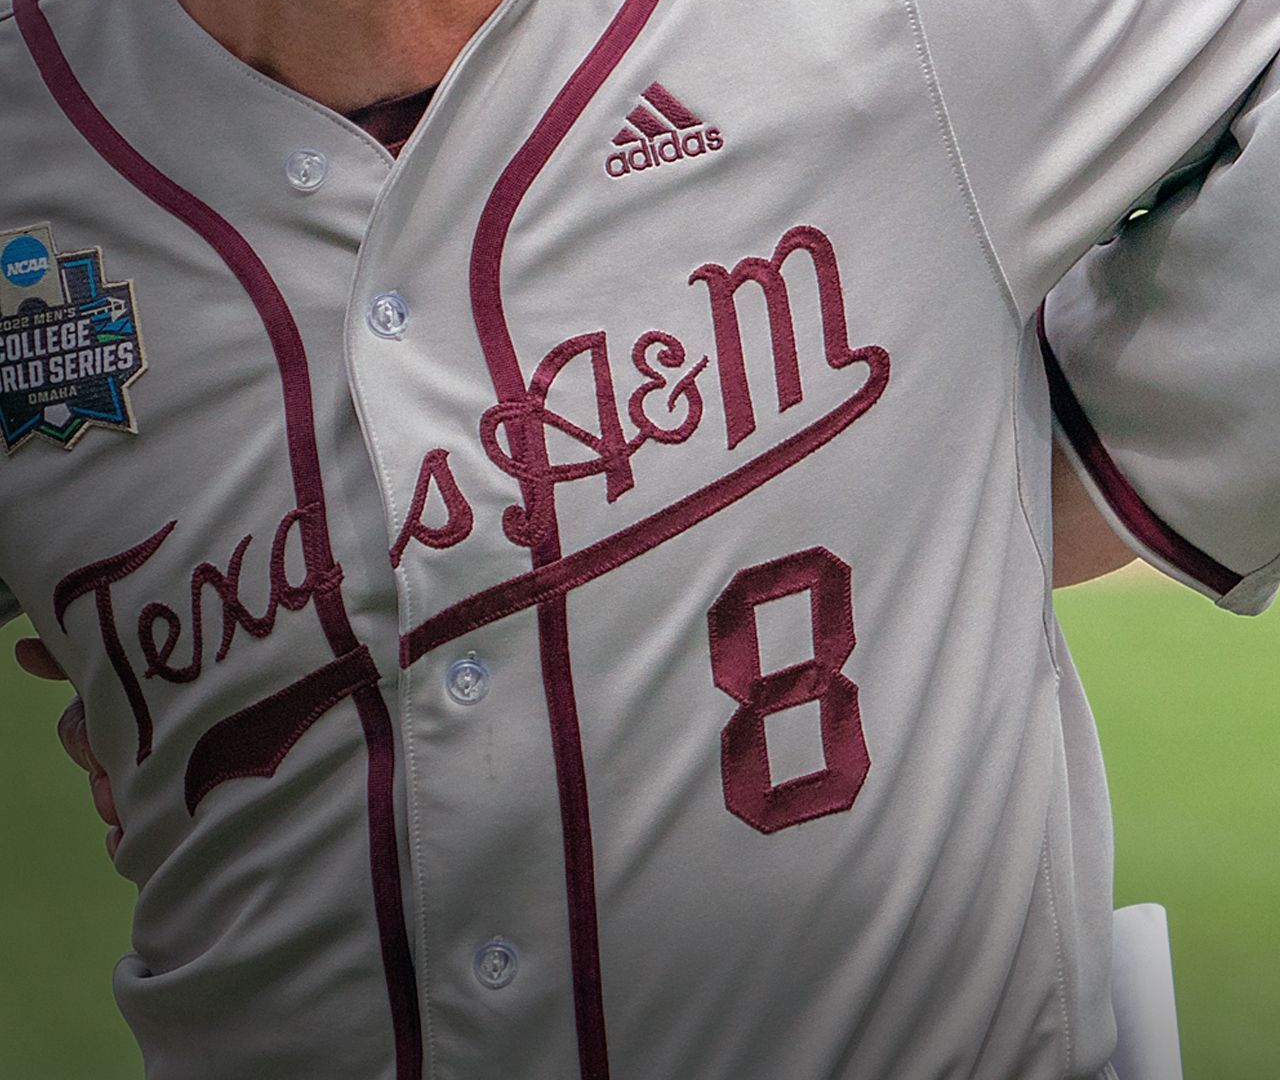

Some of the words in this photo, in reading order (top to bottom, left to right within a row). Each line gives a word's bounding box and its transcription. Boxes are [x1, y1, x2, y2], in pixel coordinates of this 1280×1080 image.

[604, 126, 725, 178] adidas
[6, 255, 50, 278] NCAA
[0, 316, 30, 332] 022
[33, 305, 77, 325] MEN'S
[0, 360, 44, 393] RLD
[49, 340, 134, 385] SERIES
[28, 385, 79, 406] OMAHA
[54, 448, 474, 766] Texas
[480, 224, 891, 548] A&M
[706, 545, 872, 834] 8
